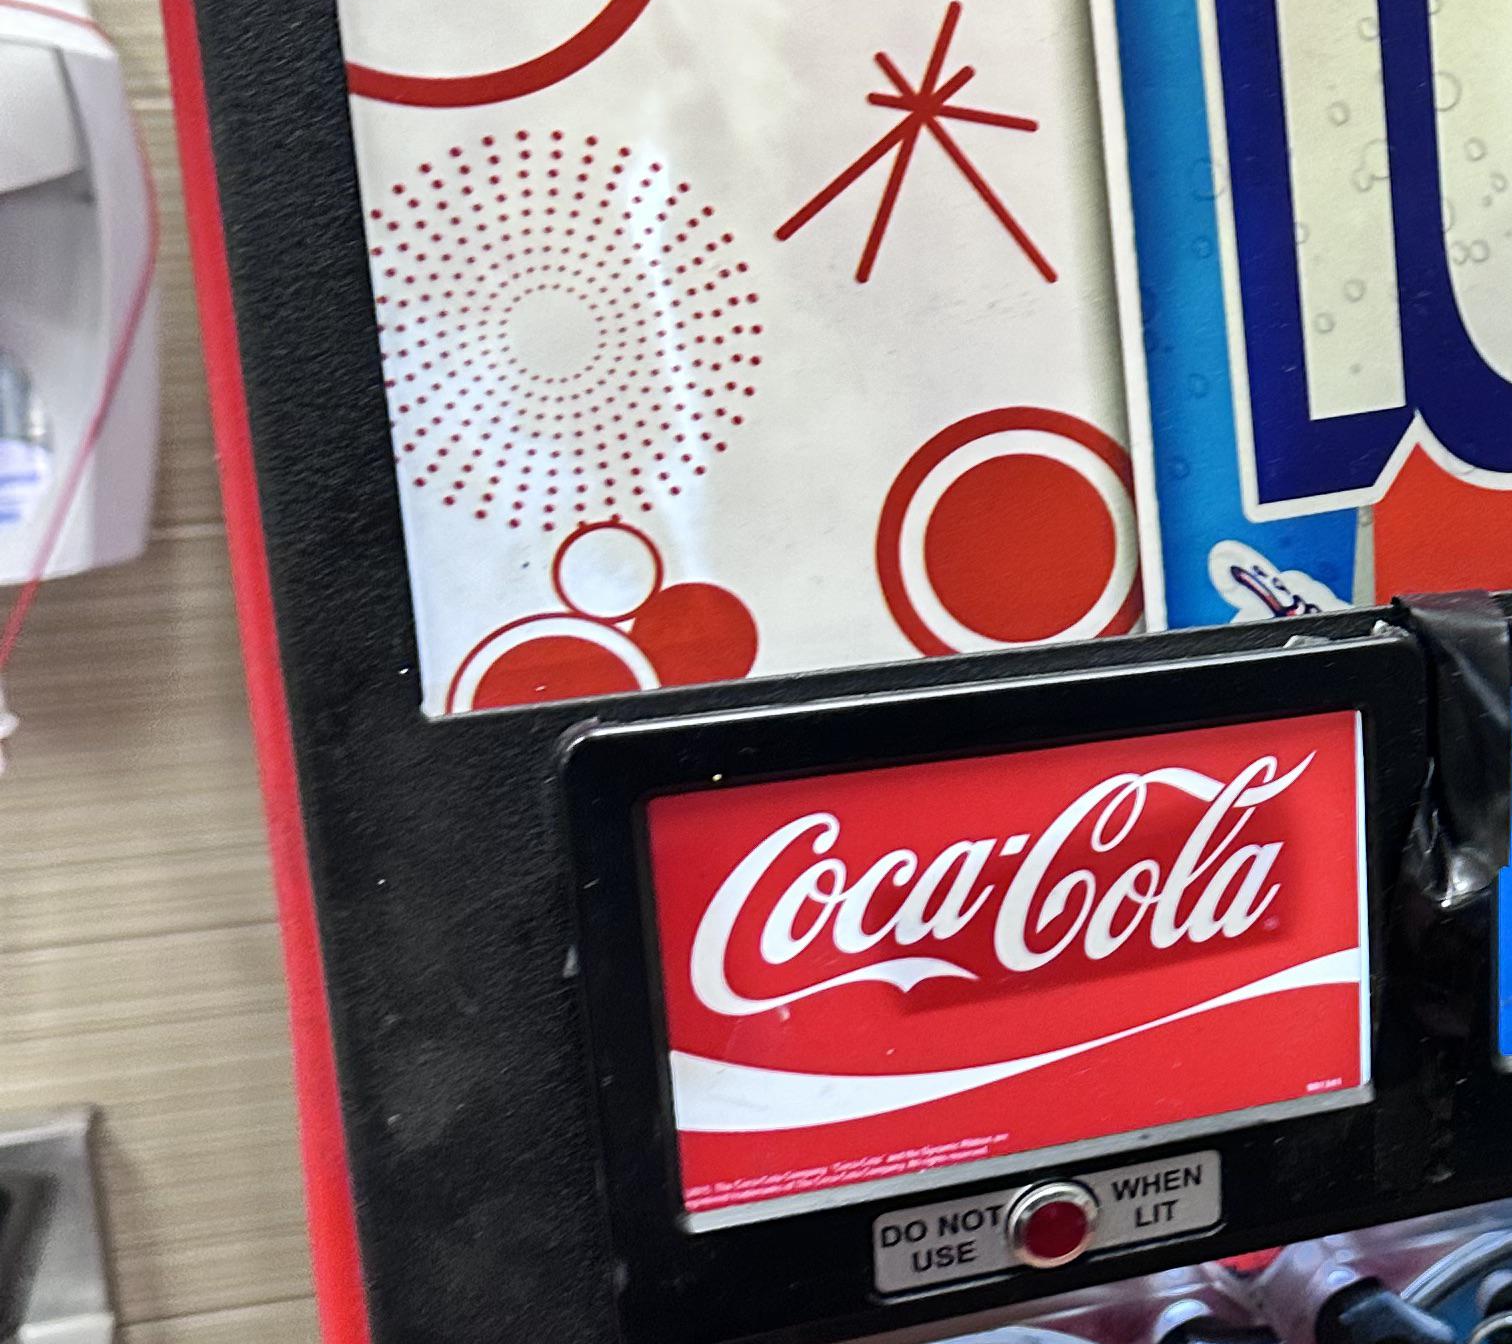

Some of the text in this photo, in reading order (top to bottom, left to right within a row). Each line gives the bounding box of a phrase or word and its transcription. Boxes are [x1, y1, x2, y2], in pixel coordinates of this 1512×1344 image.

[691, 750, 1316, 1016] Coca-Cola
[1111, 1164, 1203, 1202] WHEN
[881, 1204, 1005, 1248] DO NOT
[1135, 1200, 1178, 1228] LIT
[913, 1240, 976, 1272] USE
